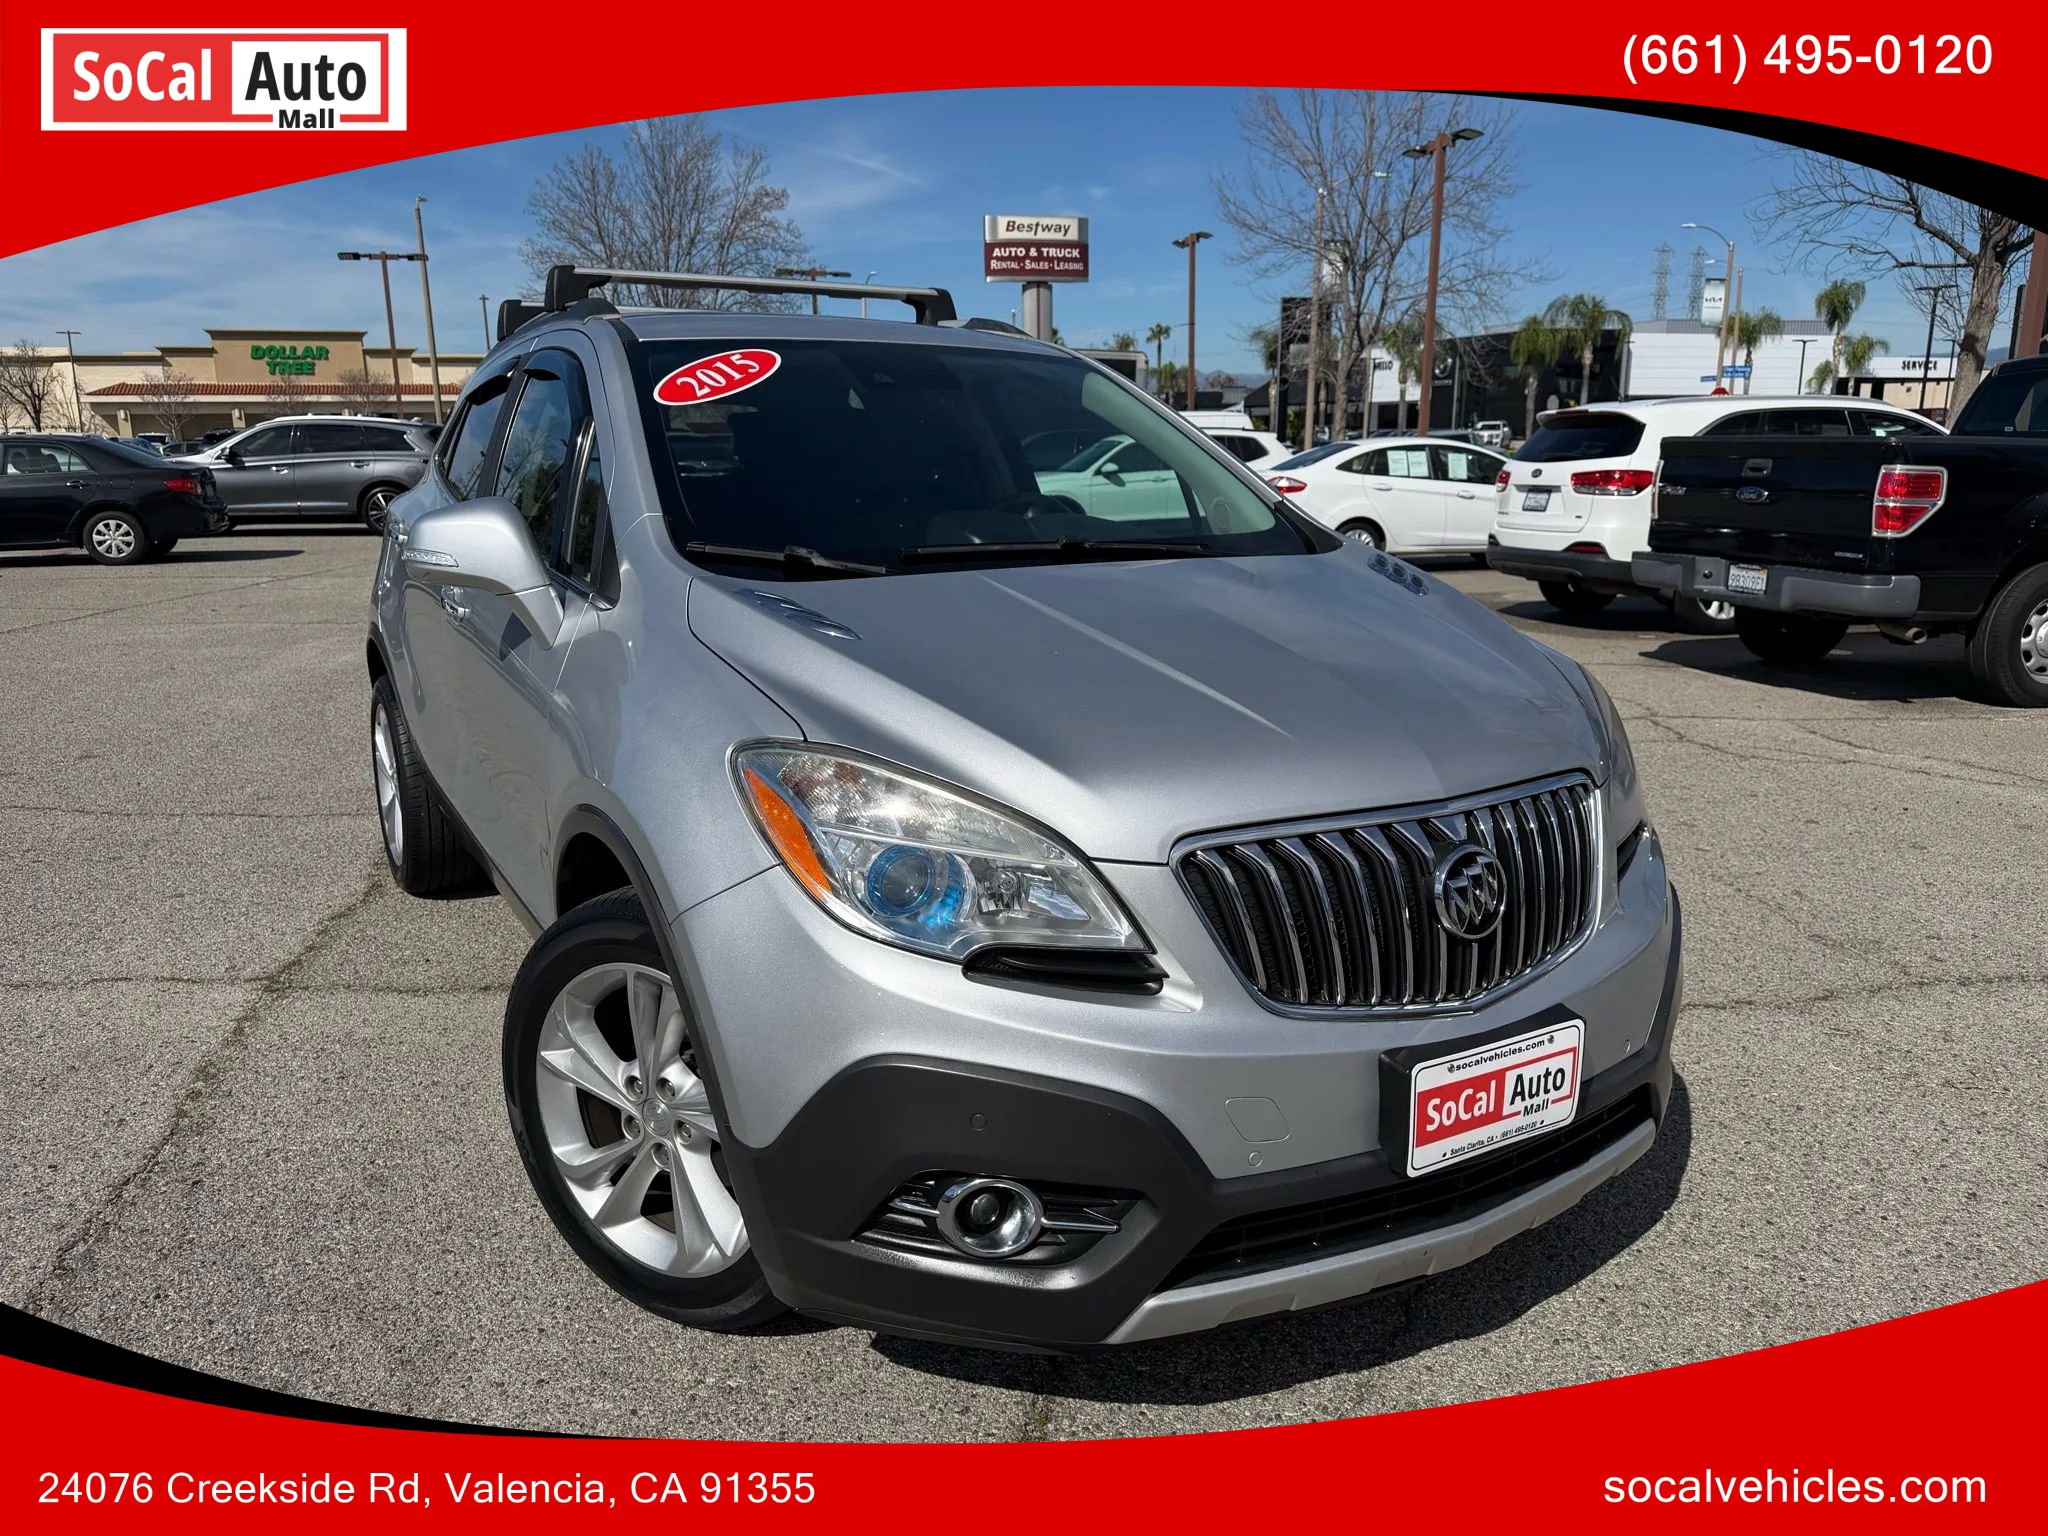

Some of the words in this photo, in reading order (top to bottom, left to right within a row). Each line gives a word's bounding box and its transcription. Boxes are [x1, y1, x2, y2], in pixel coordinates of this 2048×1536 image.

[1005, 220, 1072, 237] Bestway
[992, 247, 1026, 257] AUTO
[1029, 247, 1038, 257] &
[1041, 247, 1080, 258] TRUCK
[990, 259, 1020, 271] RENTAL
[1024, 260, 1050, 270] SALES
[1053, 260, 1084, 271] LEASING
[250, 344, 330, 361] DOLLAR
[266, 360, 316, 376] TREE
[1901, 360, 1938, 371] SERVCE
[675, 353, 760, 398] 2015
[1455, 1038, 1545, 1072] socalvehicles.com
[1425, 1079, 1497, 1132] SoCal
[1508, 1066, 1566, 1106] Auto
[1522, 1097, 1550, 1118] Mall
[1450, 1146, 1466, 1156] Santa
[1486, 1135, 1494, 1144] CA
